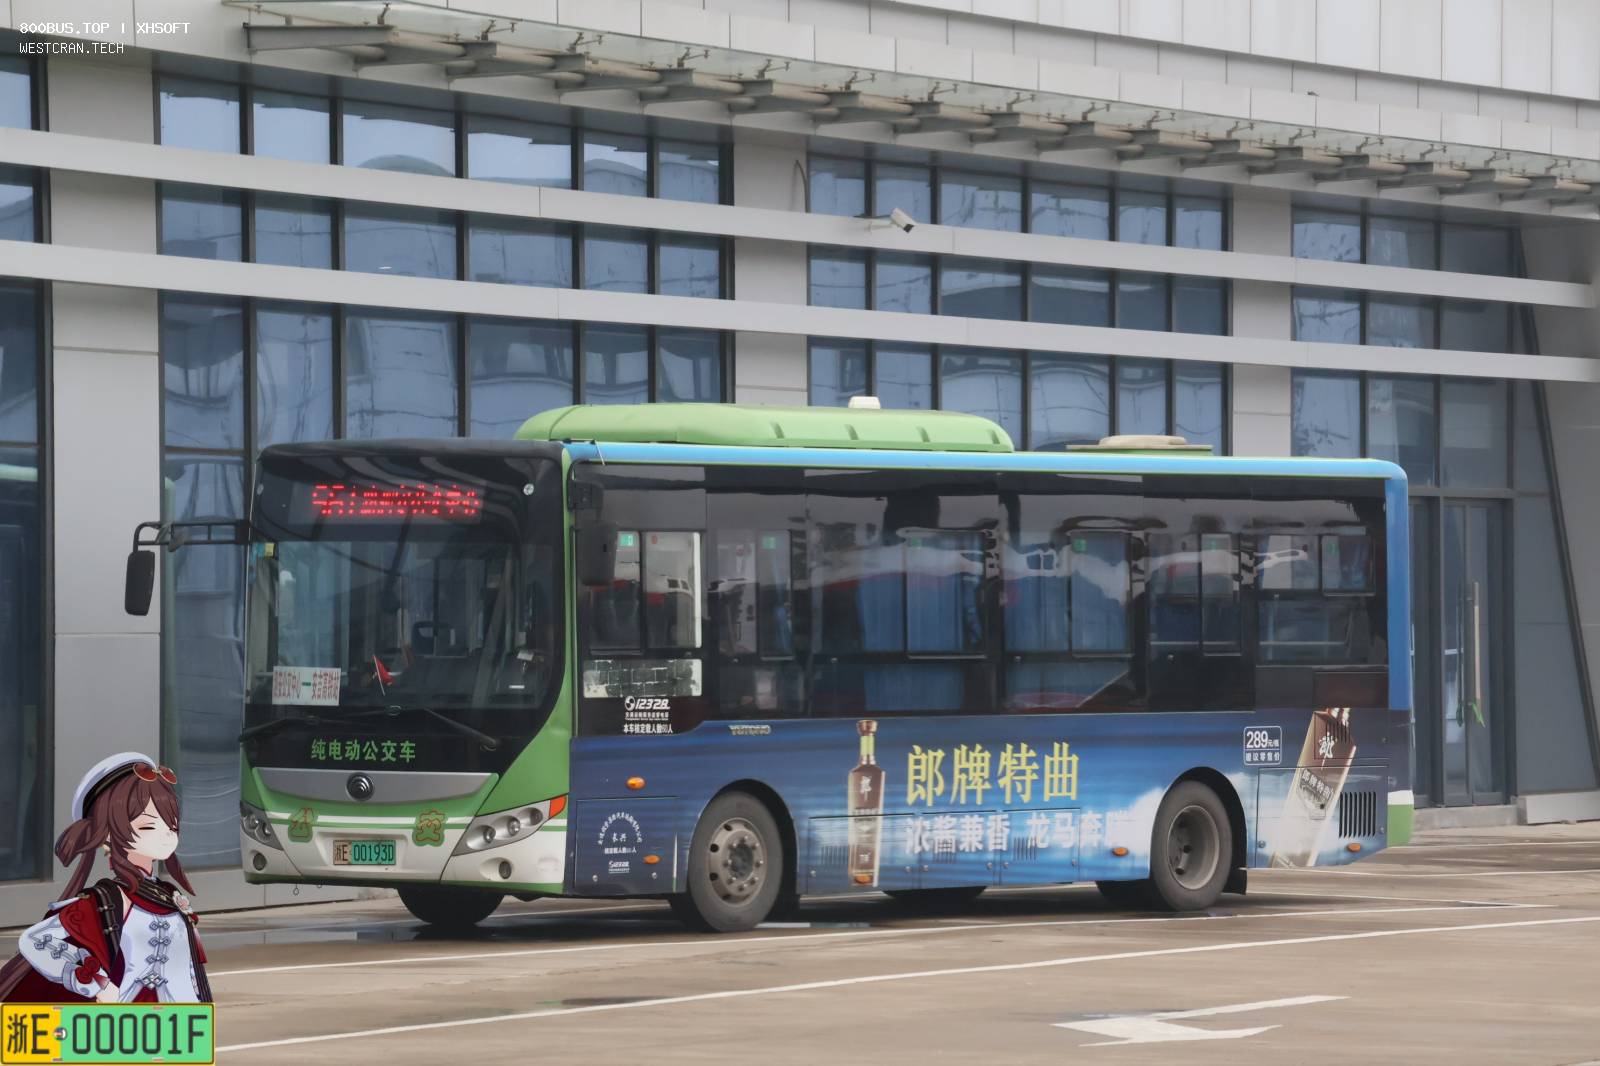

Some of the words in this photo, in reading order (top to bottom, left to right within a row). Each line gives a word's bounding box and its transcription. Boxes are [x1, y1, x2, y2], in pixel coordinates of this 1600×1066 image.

[635, 698, 671, 710] 12328
[311, 738, 416, 763] 纯电动公交车
[906, 741, 1080, 807] 郎牌特曲
[904, 814, 1011, 854] 浓酱兼香
